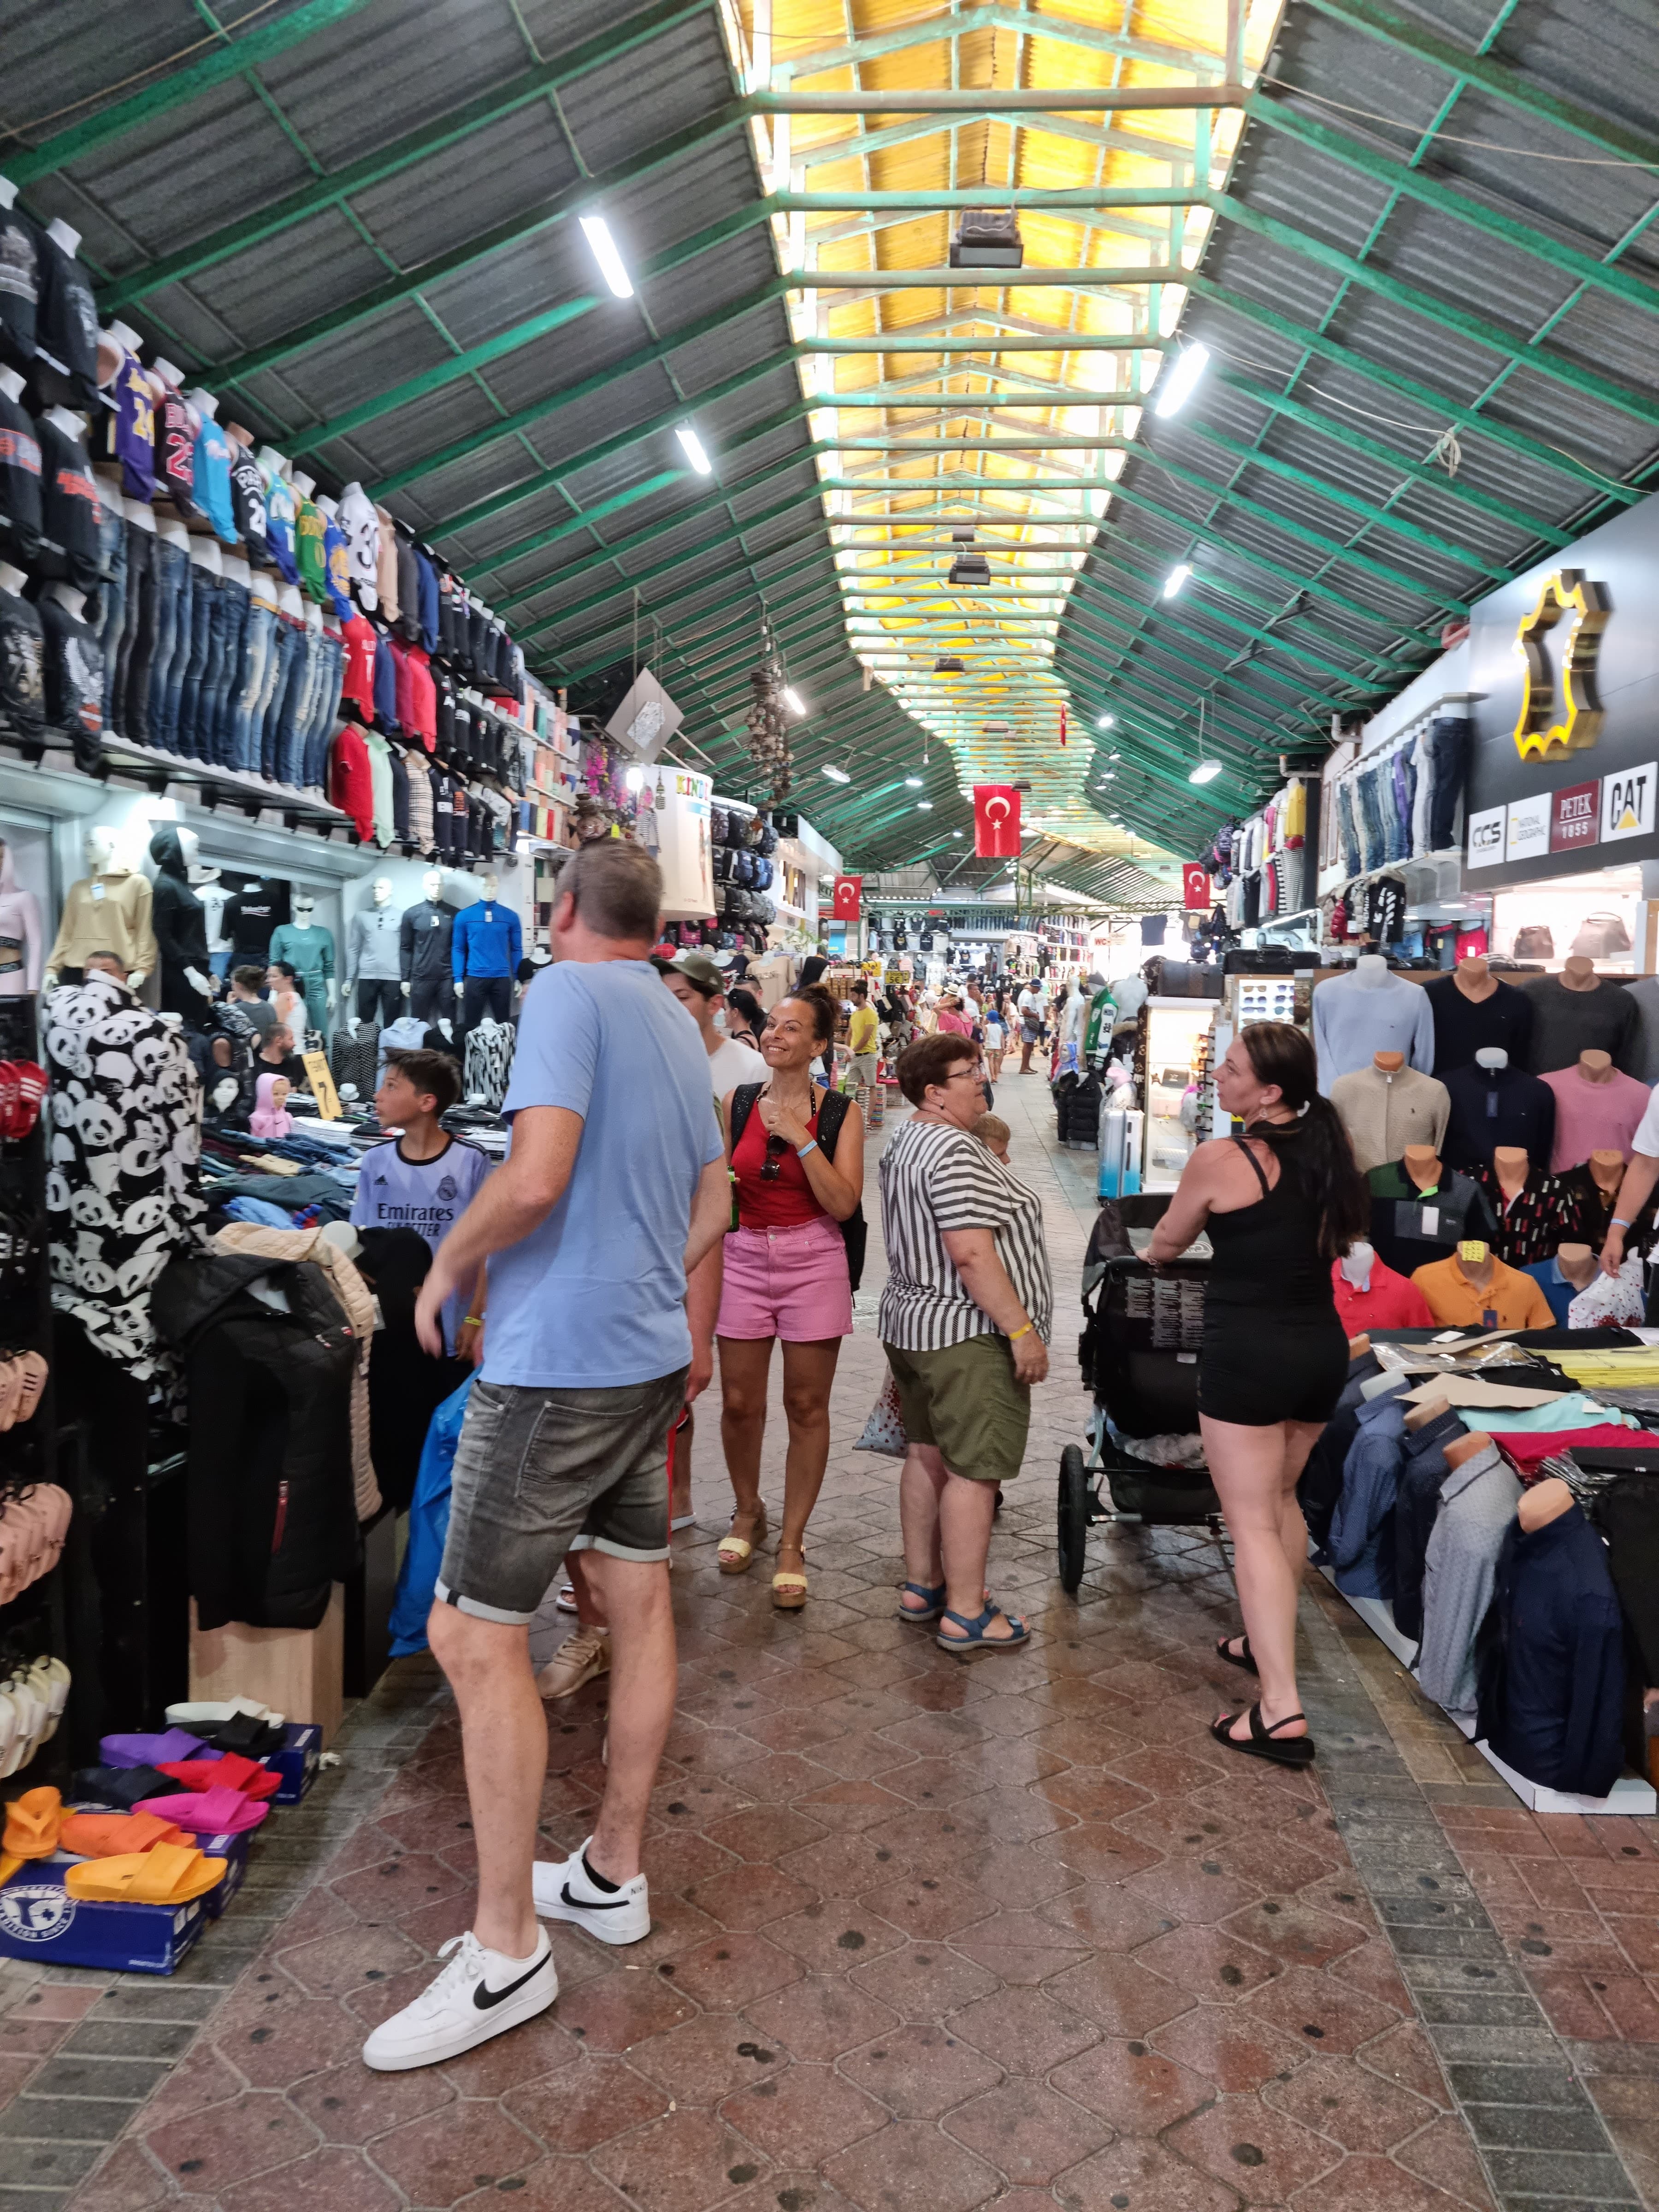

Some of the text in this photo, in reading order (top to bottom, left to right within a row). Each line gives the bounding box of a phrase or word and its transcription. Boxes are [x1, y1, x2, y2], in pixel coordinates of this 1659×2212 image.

[1560, 793, 1593, 820] PETEK
[1612, 775, 1647, 831] CAT
[1473, 820, 1501, 848] CCS
[1561, 821, 1588, 839] 1855
[377, 1203, 455, 1221] Emirates
